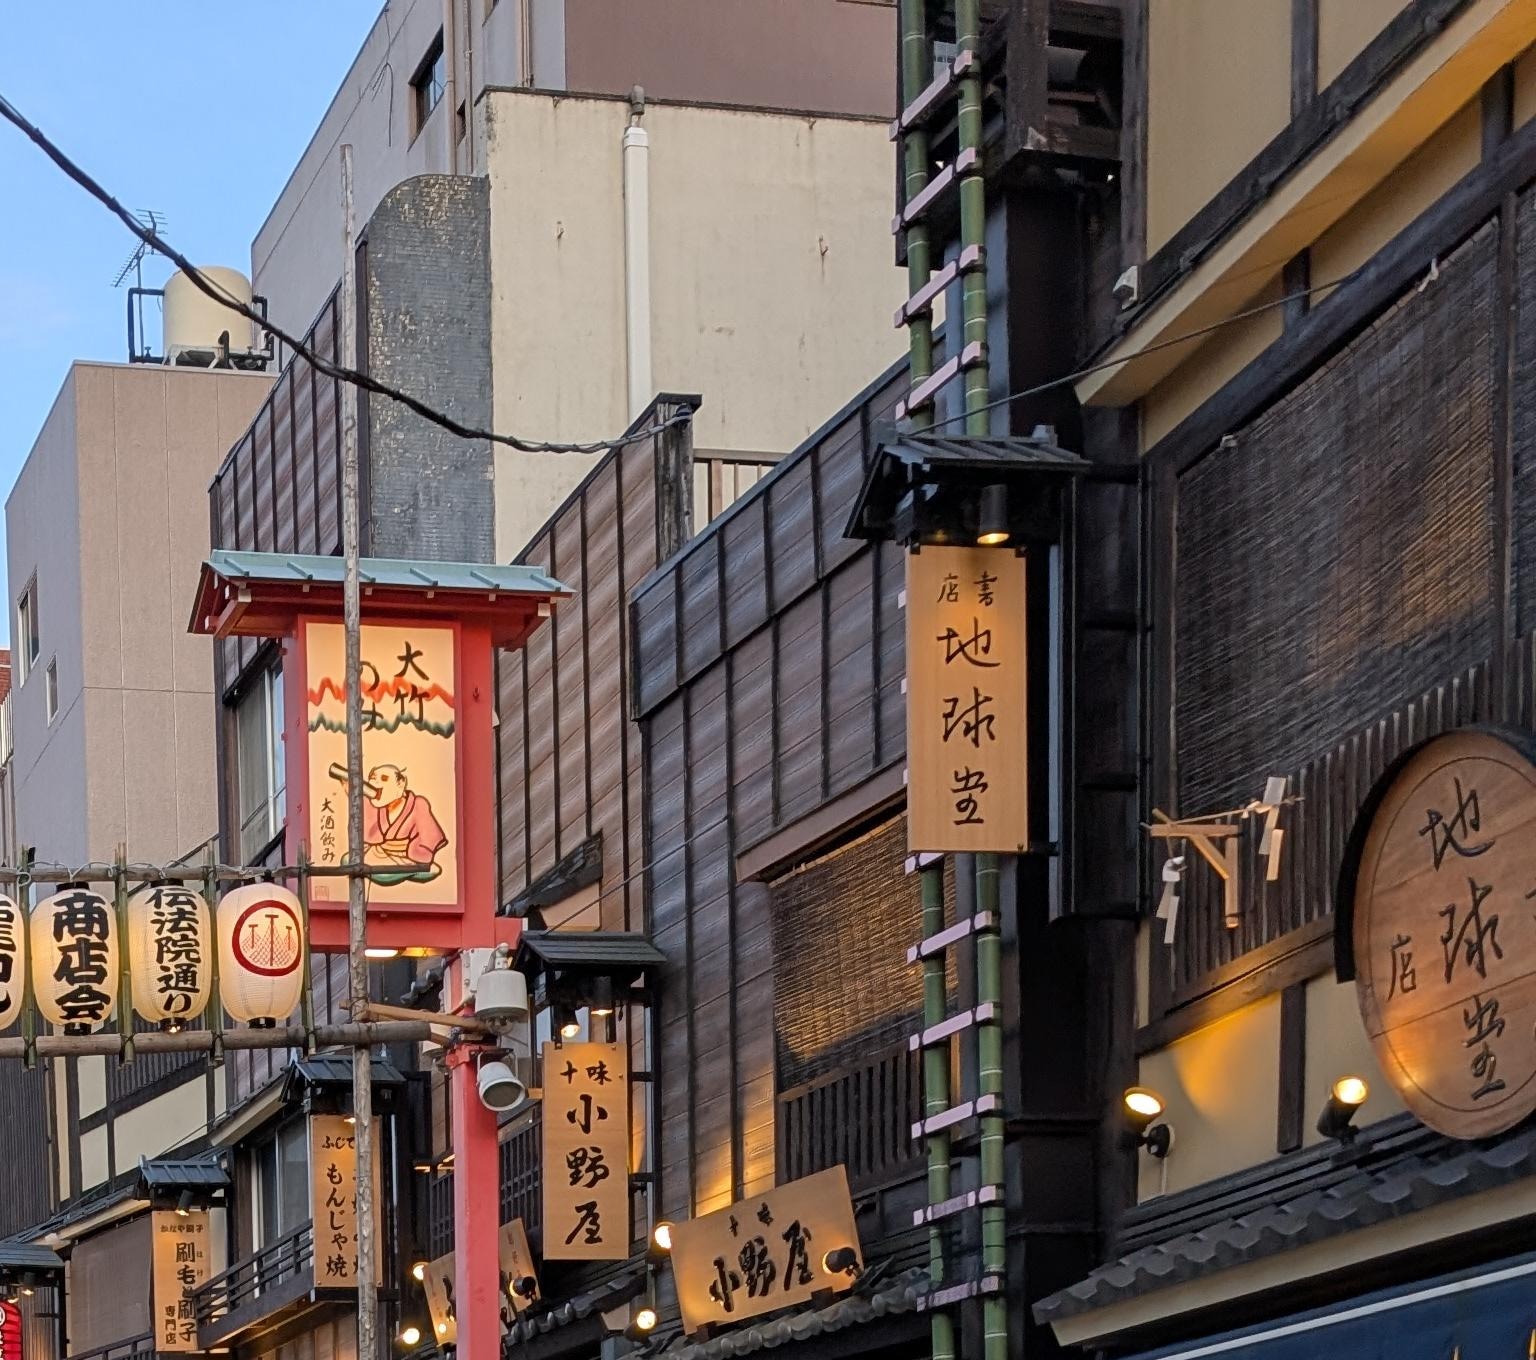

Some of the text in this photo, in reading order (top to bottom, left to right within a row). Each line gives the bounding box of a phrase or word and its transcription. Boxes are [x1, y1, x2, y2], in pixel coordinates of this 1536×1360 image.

[936, 616, 1001, 825] 地球堂
[320, 798, 335, 863] 大酒飲み
[51, 892, 112, 1022] 商店会
[151, 887, 202, 1013] 伝法院通り
[325, 1162, 348, 1278] もんじゃ焼
[565, 1094, 610, 1245] 小野屋
